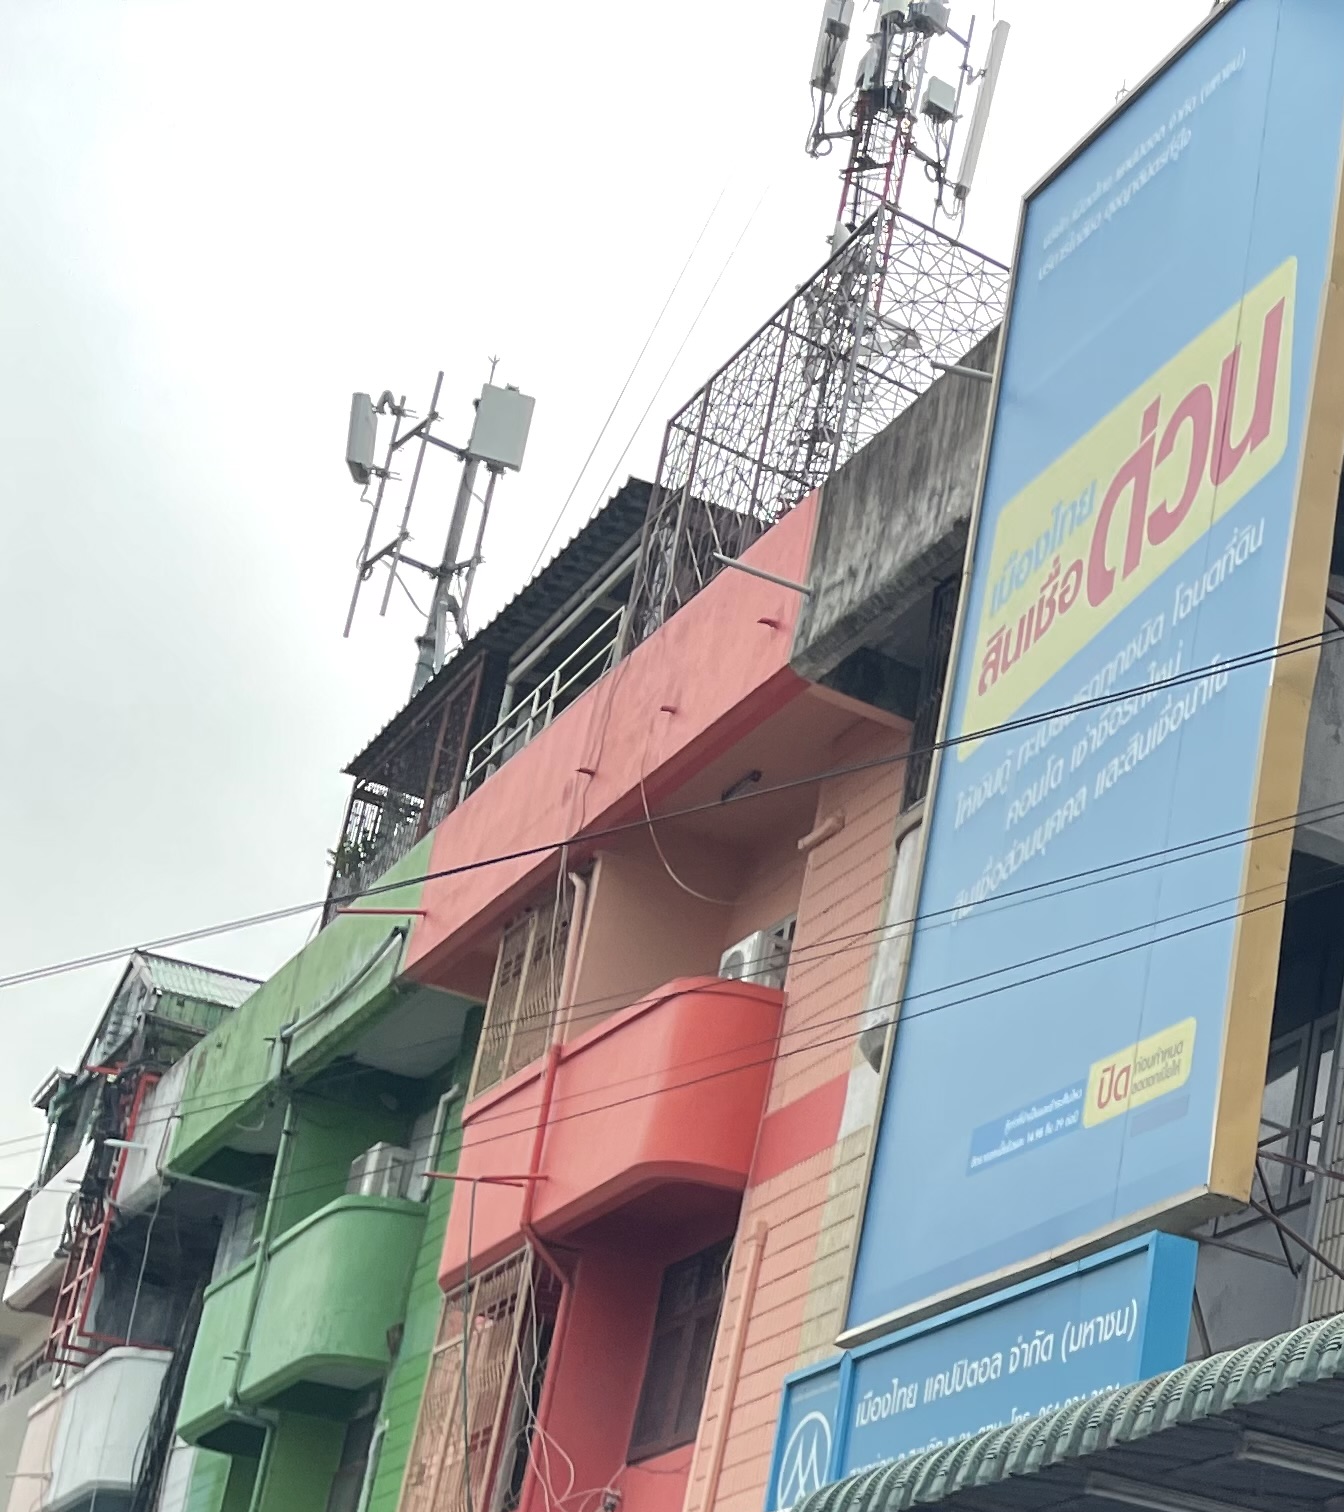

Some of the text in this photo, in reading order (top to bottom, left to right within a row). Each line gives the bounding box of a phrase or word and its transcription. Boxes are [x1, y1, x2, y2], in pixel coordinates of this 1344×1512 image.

[977, 296, 1286, 697] สินเชื่อ ด่วน
[1171, 518, 1265, 627] โฉนดที่ดิน
[1097, 1062, 1132, 1110] ปิด
[854, 1377, 919, 1428] เมืองไทย
[923, 1351, 1003, 1402] แคปปิตอล
[1007, 1328, 1054, 1376] จำกัด
[1060, 1298, 1138, 1364] (มหาชน)
